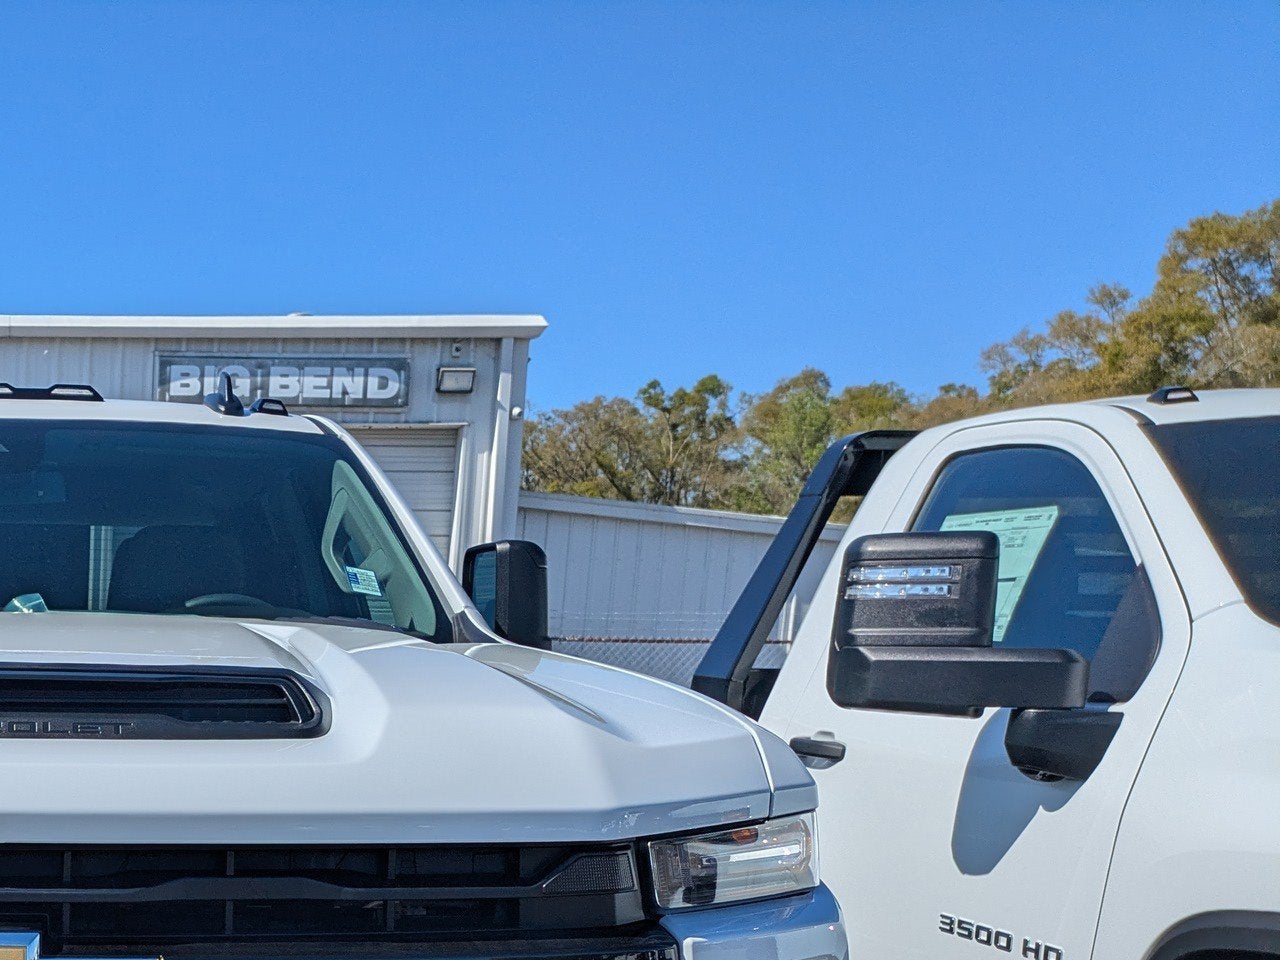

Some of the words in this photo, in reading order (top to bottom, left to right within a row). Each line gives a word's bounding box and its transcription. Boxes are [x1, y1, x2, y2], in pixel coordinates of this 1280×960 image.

[170, 364, 250, 397] BIG
[268, 366, 400, 399] BEND
[938, 912, 1014, 953] 3500
